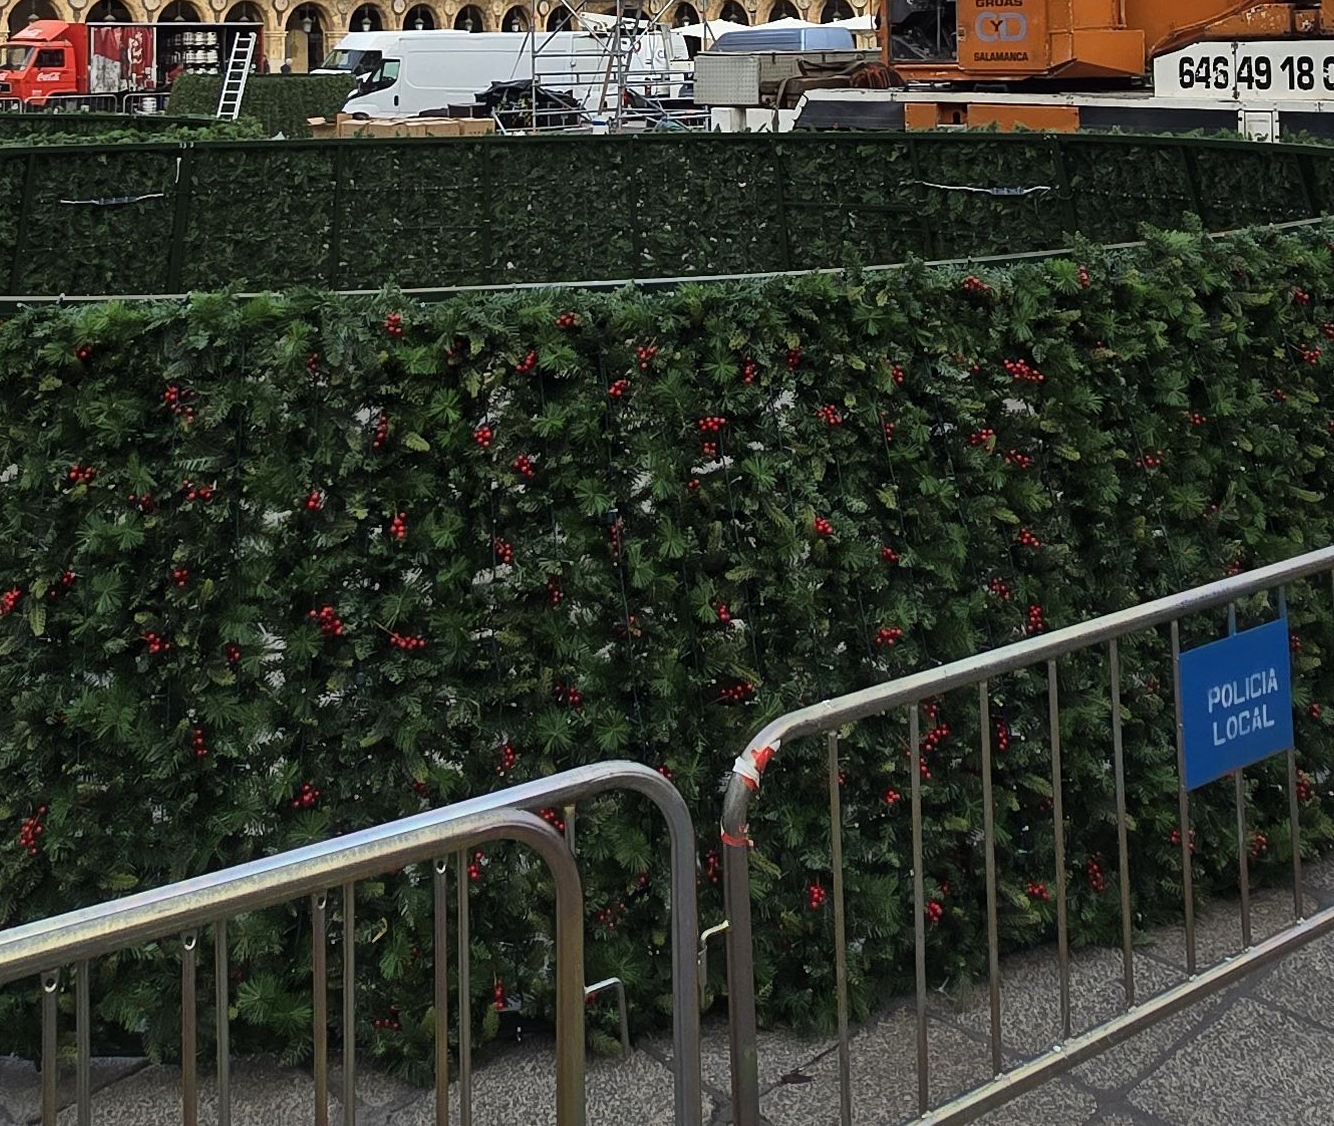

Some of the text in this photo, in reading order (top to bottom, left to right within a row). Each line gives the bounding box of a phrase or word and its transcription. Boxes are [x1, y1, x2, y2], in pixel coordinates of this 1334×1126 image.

[974, 52, 1029, 61] SALAMANCA
[1179, 56, 1229, 90] 646
[1236, 56, 1272, 91] 49
[1280, 56, 1315, 91] 18
[1208, 668, 1278, 713] POLICIA
[1213, 704, 1275, 746] LOCAL
